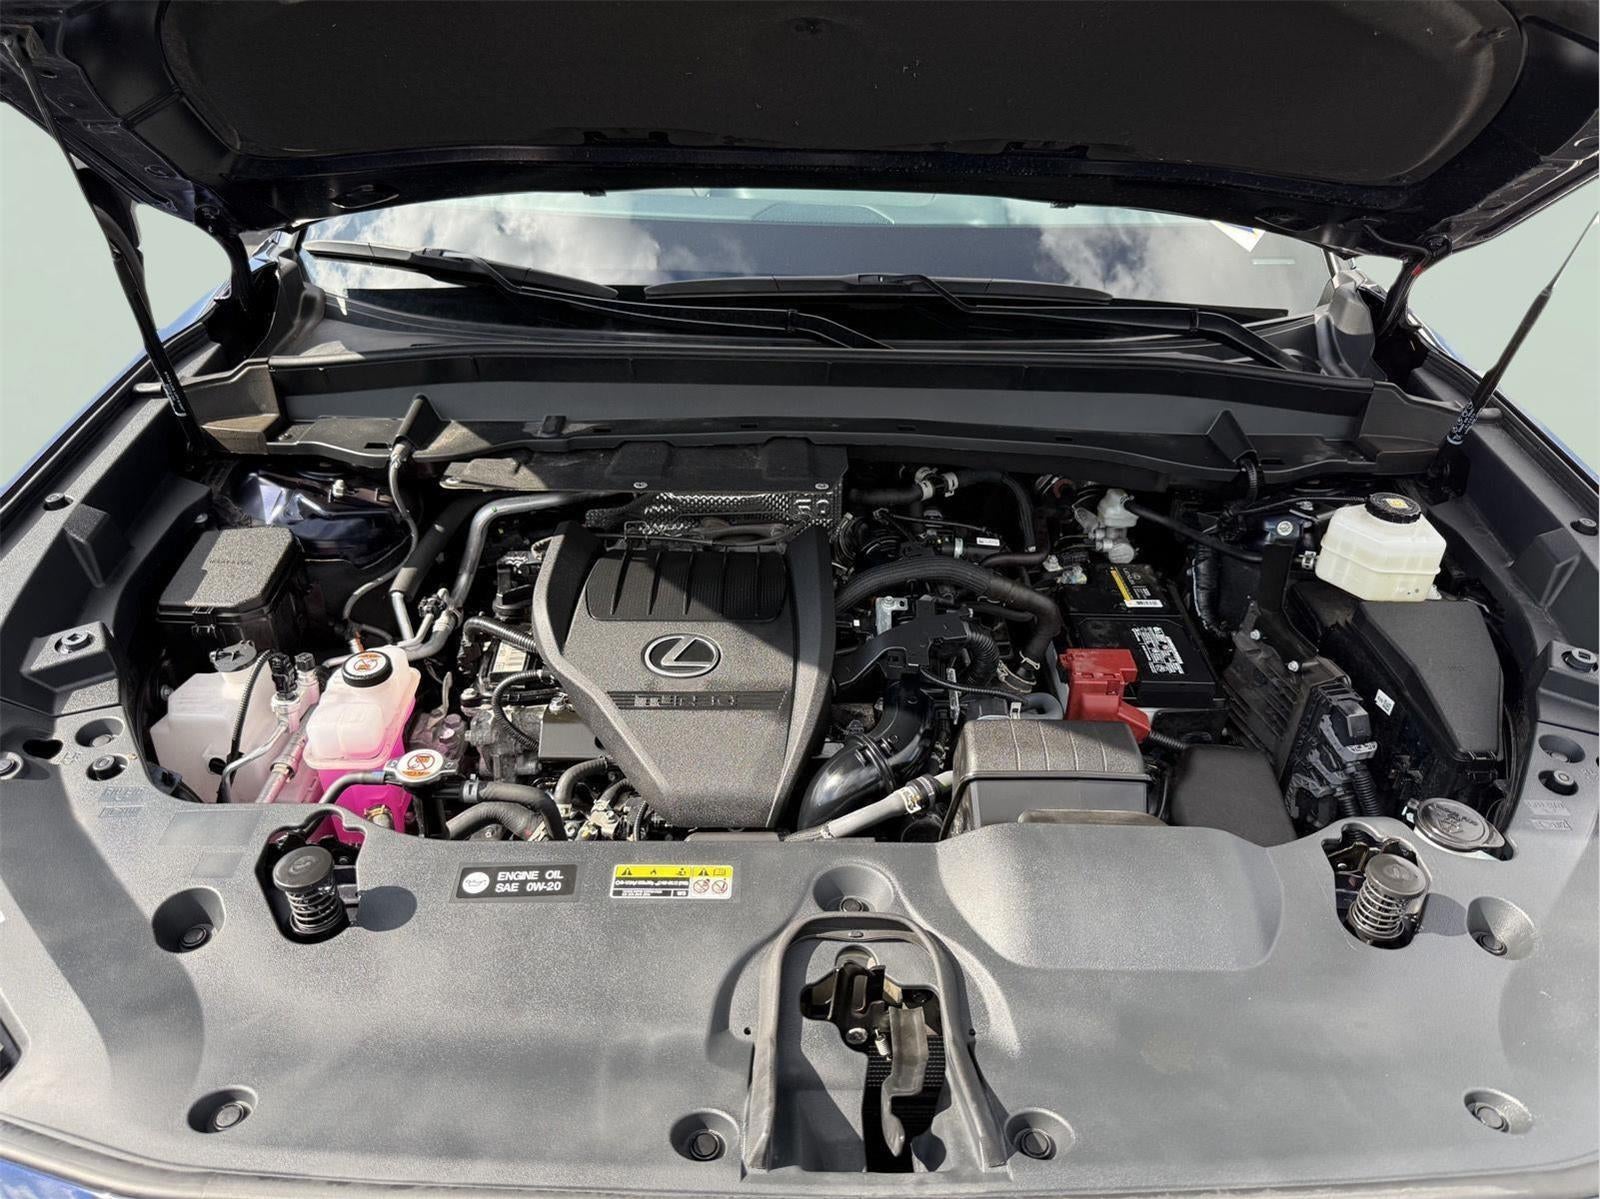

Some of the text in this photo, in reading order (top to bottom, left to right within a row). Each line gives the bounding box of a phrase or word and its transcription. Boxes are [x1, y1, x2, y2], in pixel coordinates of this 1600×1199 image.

[497, 870, 564, 880] ENGINE OIL
[495, 882, 561, 892] SAE 0W-20
